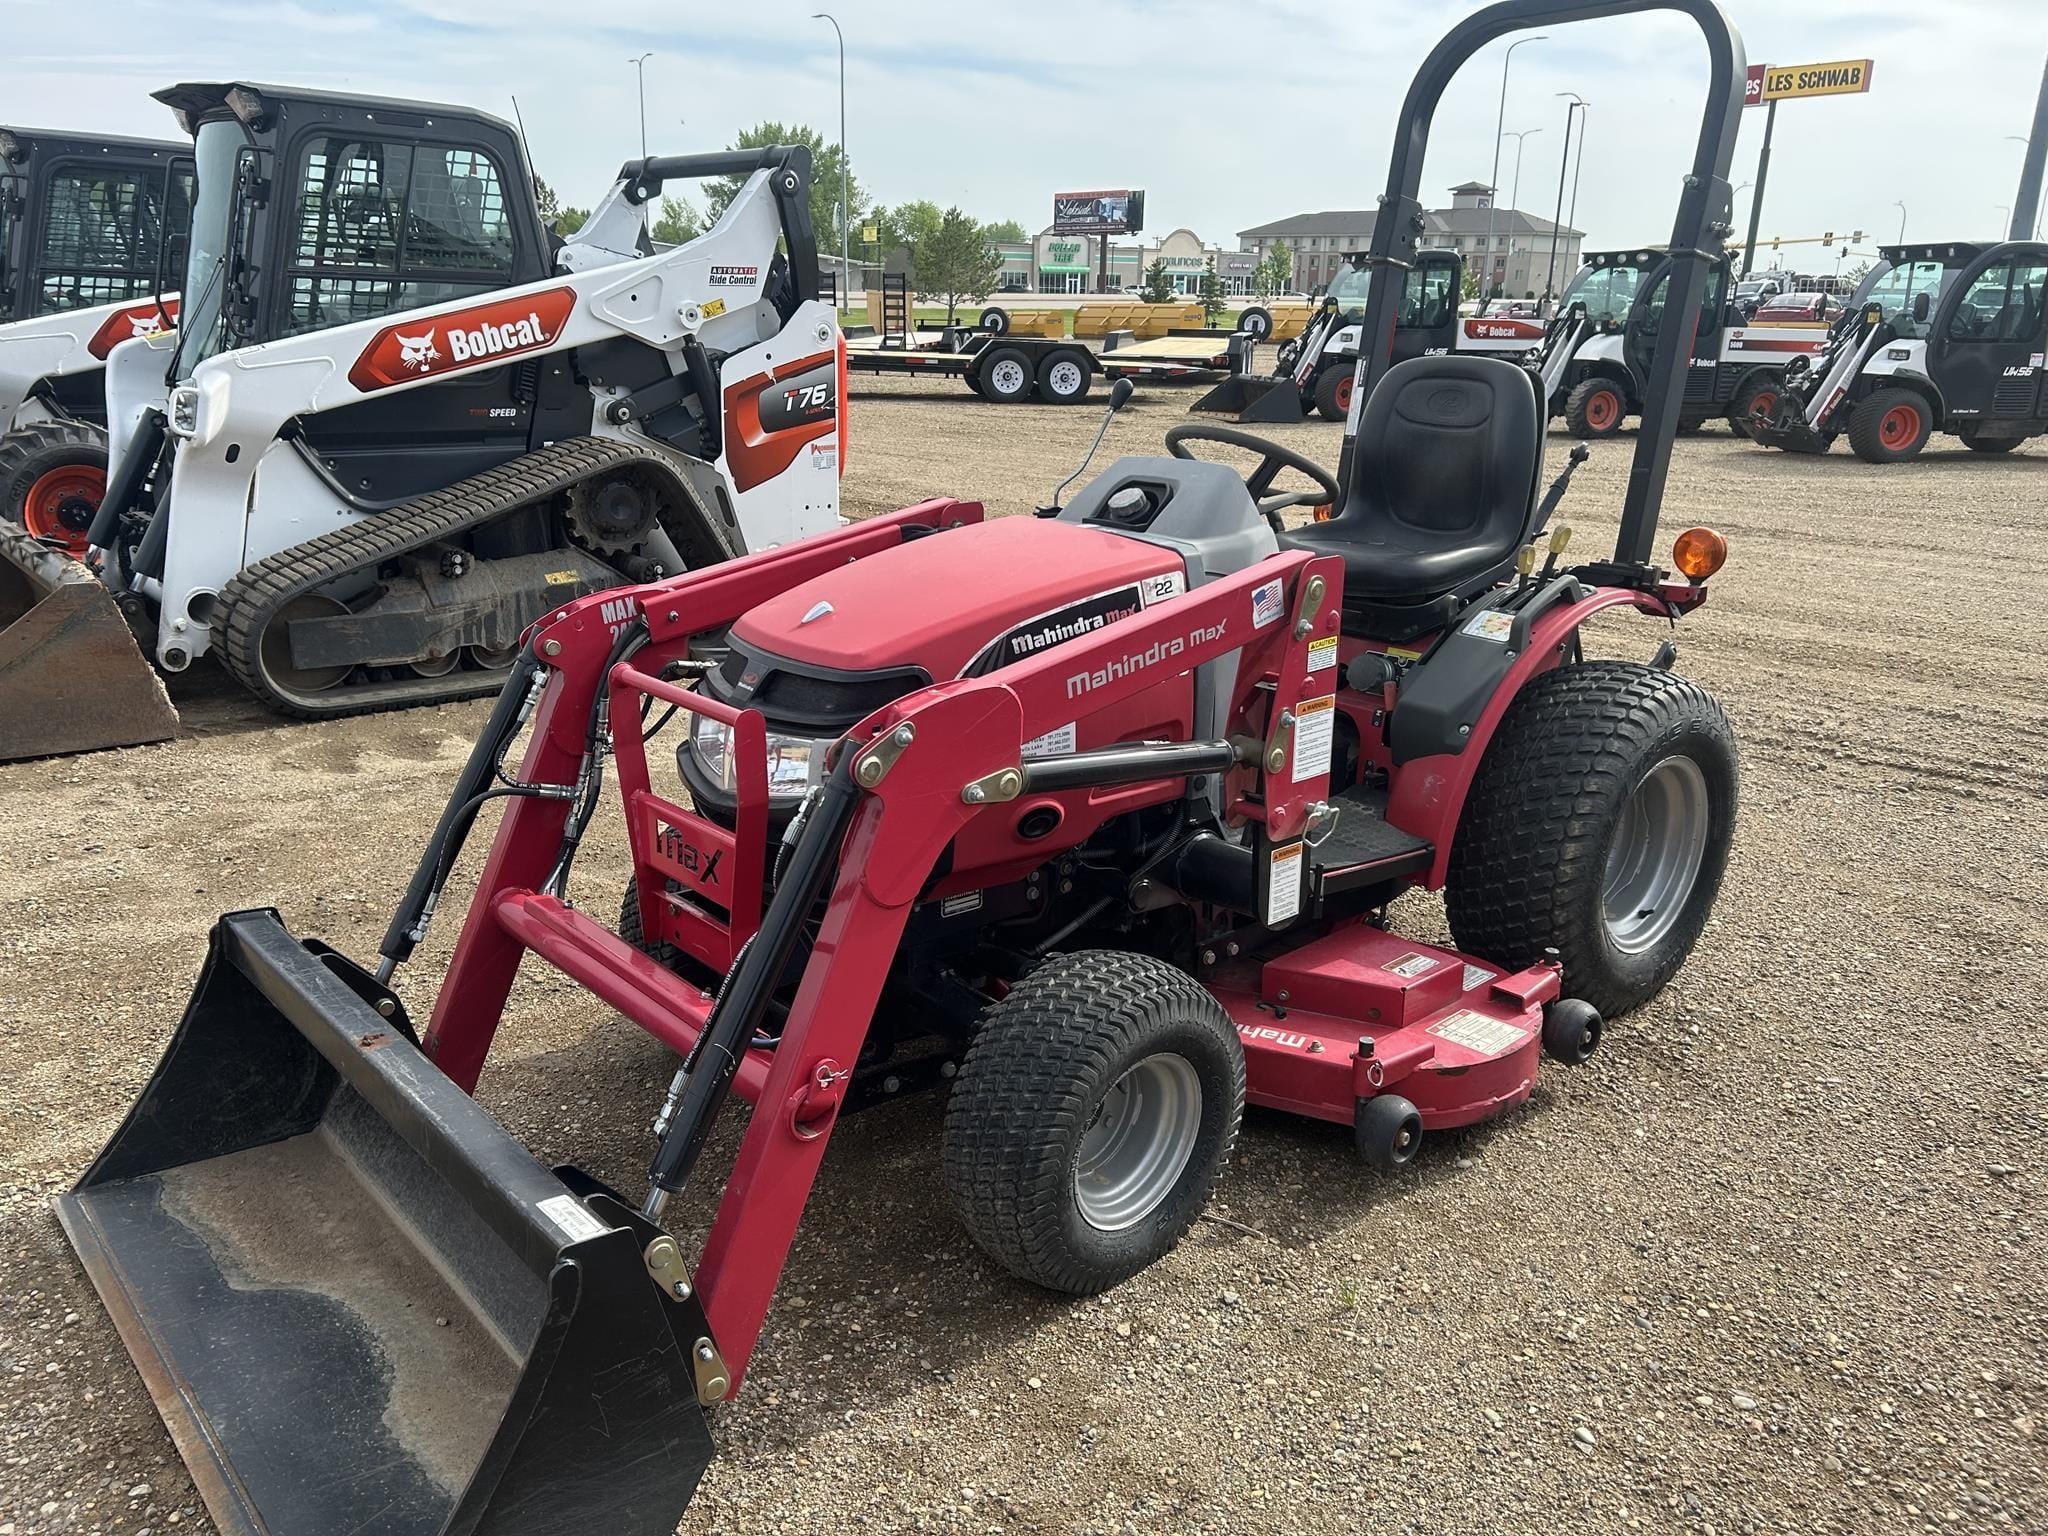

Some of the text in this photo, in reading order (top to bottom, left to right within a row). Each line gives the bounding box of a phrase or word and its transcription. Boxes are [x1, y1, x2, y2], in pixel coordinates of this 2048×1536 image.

[1767, 67, 1861, 92] LES SCHWAB
[1049, 242, 1081, 253] DOLLAR
[1053, 253, 1075, 262] TREE
[1160, 256, 1203, 267] maurices
[712, 267, 757, 275] AUTOMATIC
[709, 275, 757, 285] Ride Control
[447, 312, 545, 362] Bobcat
[1489, 326, 1515, 337] Bobcat
[1696, 358, 1717, 368] Bobcat
[783, 383, 828, 412] T76
[489, 408, 517, 418] SPEED
[1155, 580, 1173, 597] 22
[600, 595, 638, 625] MAX
[1011, 614, 1104, 655] Mahindra
[1315, 638, 1336, 648] CAUTION
[1066, 636, 1185, 700] Mahindra
[1306, 700, 1328, 711] WARNING
[1278, 845, 1300, 858] WARNING
